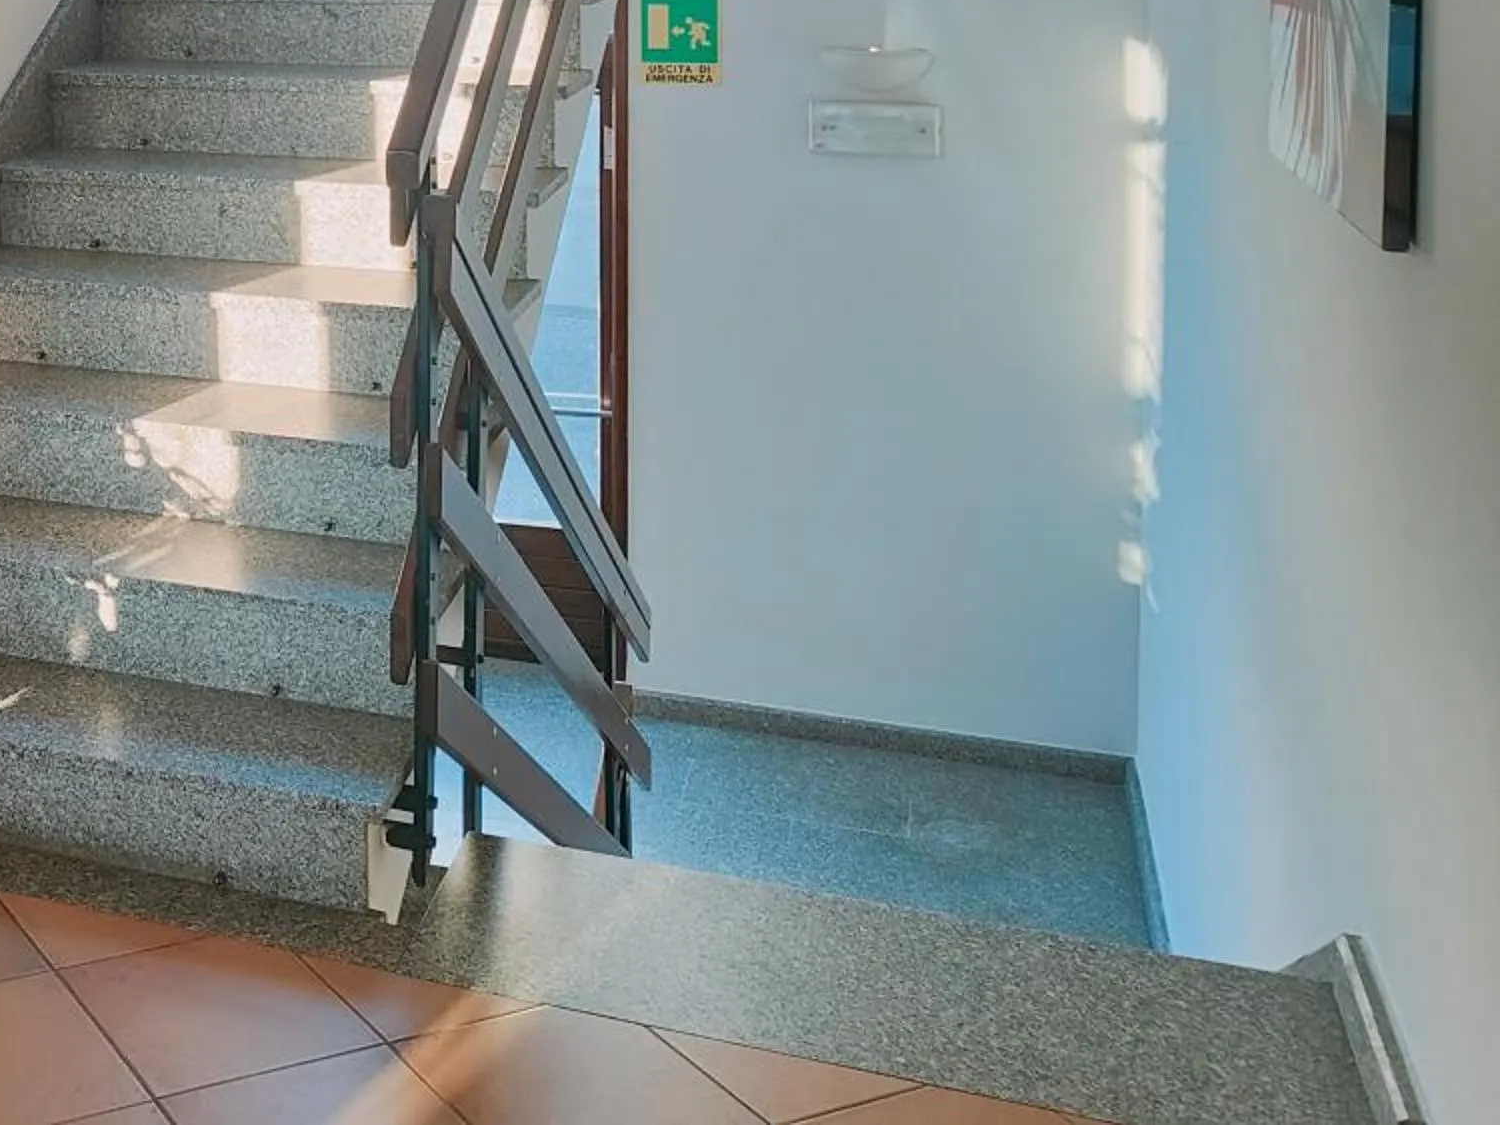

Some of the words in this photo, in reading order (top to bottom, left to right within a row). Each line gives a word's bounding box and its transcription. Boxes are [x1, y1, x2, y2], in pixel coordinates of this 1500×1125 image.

[648, 64, 693, 74] USCITA
[699, 64, 711, 74] DI
[645, 74, 713, 84] EMERGENZA
